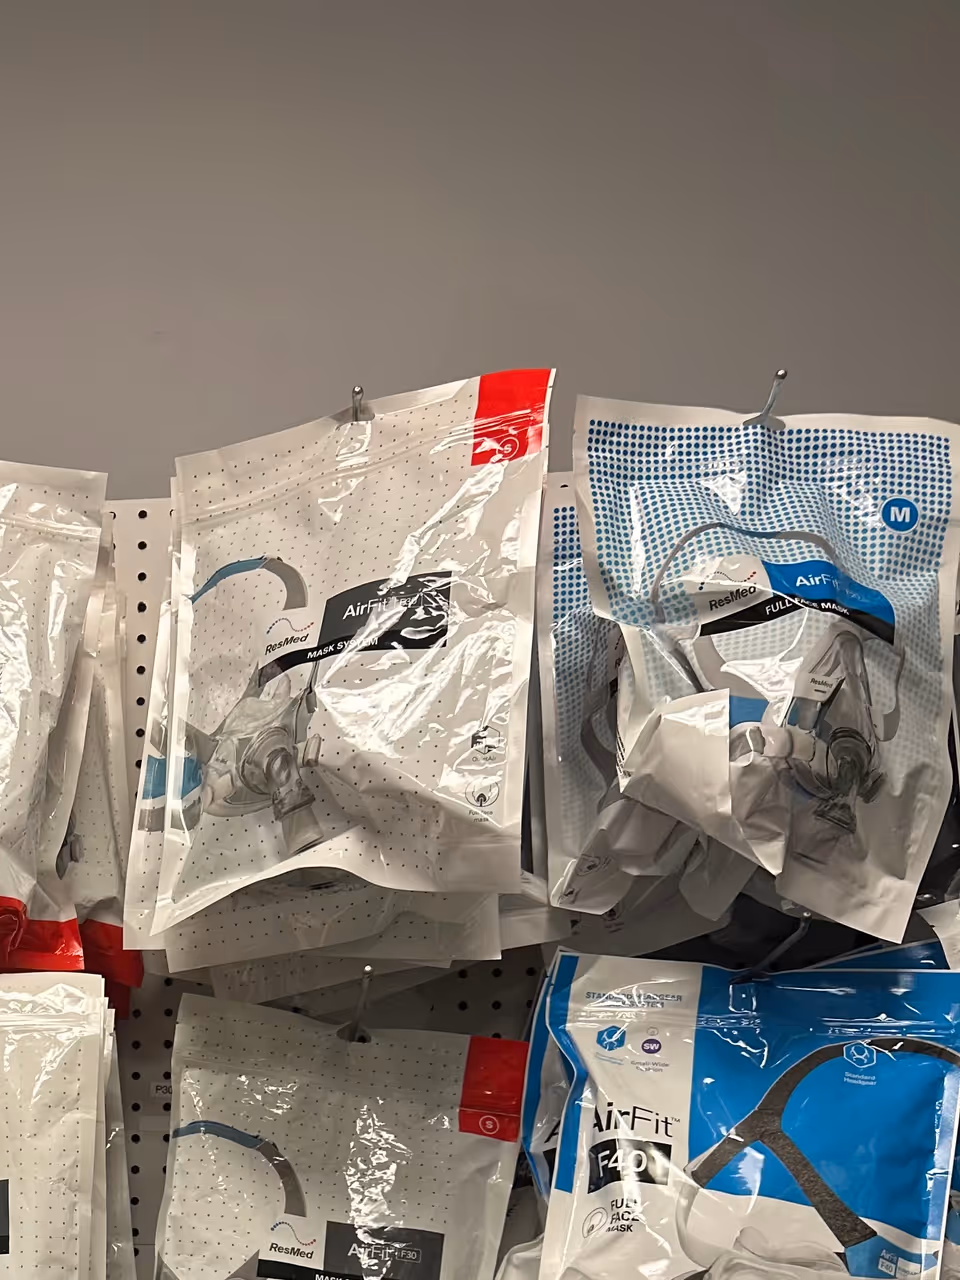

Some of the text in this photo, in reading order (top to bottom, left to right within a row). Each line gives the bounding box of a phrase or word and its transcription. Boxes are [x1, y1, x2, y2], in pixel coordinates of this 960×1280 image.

[890, 506, 910, 523] M
[708, 584, 757, 611] ResMed
[765, 599, 849, 615] FULL MASK
[264, 633, 309, 656] ResMed
[307, 636, 378, 659] MASK SYSTEM
[810, 679, 833, 688] ResMed
[844, 1072, 877, 1080] Standard
[844, 1078, 878, 1086] Headgear
[486, 1121, 493, 1129] S
[606, 1223, 633, 1233] MASK
[269, 1242, 314, 1259] ResMed
[401, 1250, 417, 1259] F30
